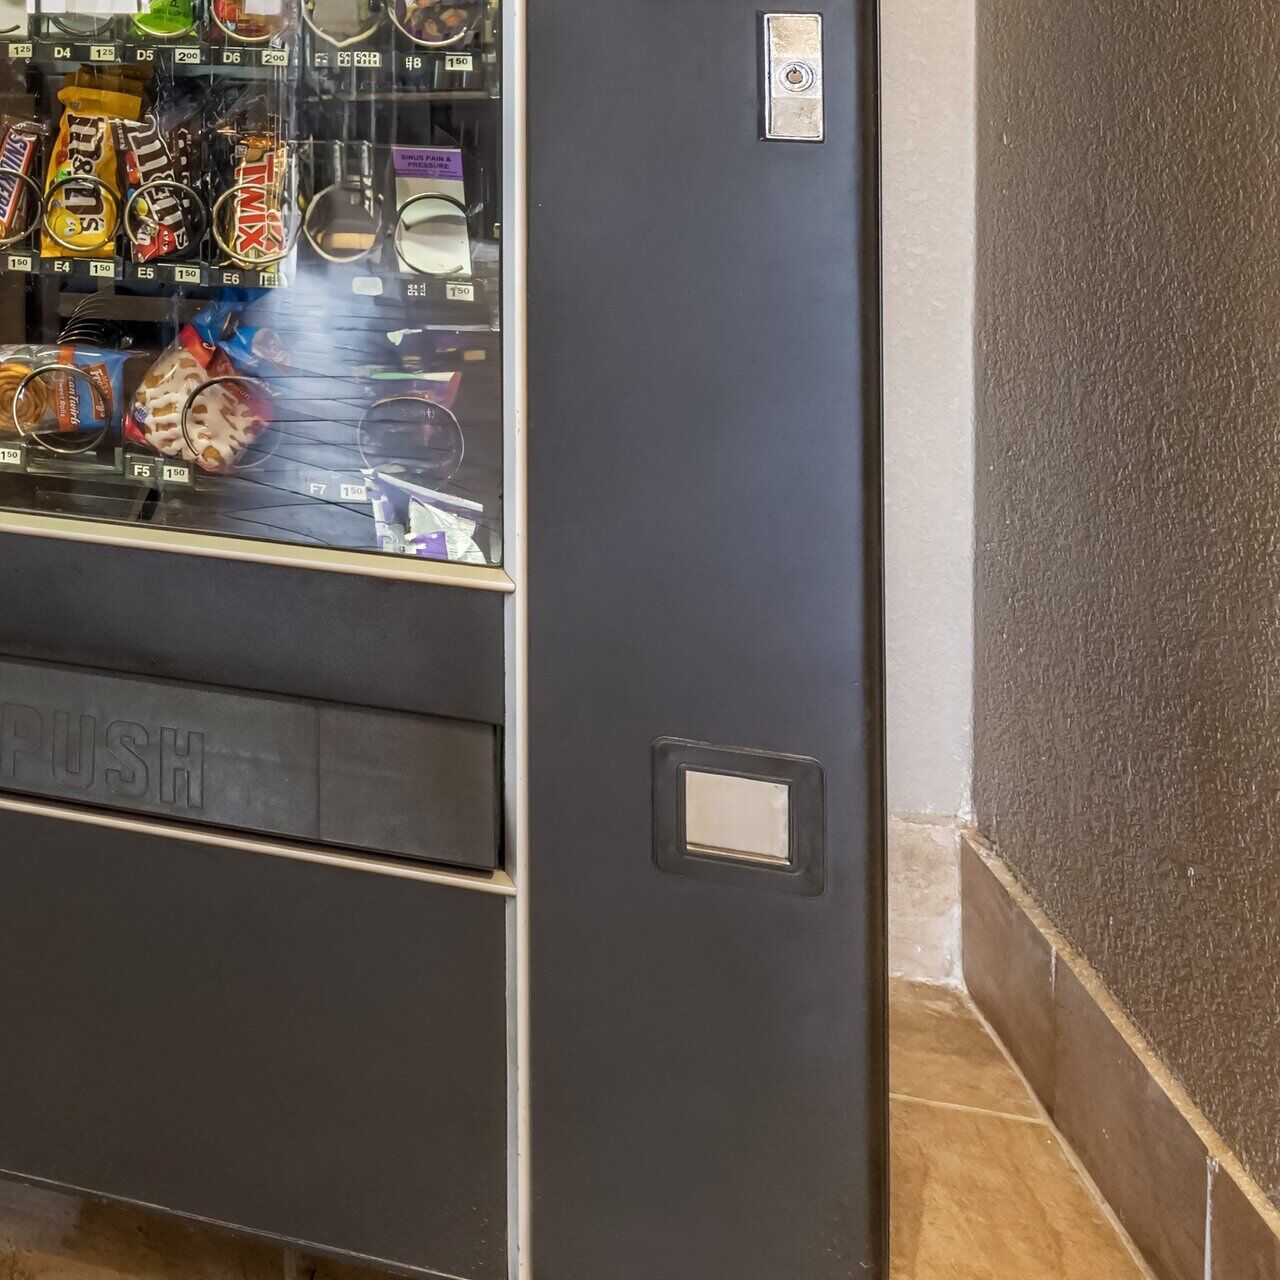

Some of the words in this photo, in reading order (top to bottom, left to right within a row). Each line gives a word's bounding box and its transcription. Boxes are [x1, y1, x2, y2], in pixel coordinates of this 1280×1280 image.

[54, 46, 72, 58] D4
[136, 49, 154, 61] D5
[222, 51, 241, 63] D6
[425, 155, 444, 163] PAIN
[408, 162, 450, 170] PRESSURE
[235, 152, 276, 256] TWIX
[54, 261, 70, 272] E4
[137, 268, 154, 279] E5
[222, 273, 240, 285] E6
[134, 464, 151, 477] F5
[310, 483, 327, 495] F7
[0, 702, 205, 810] PUSH
